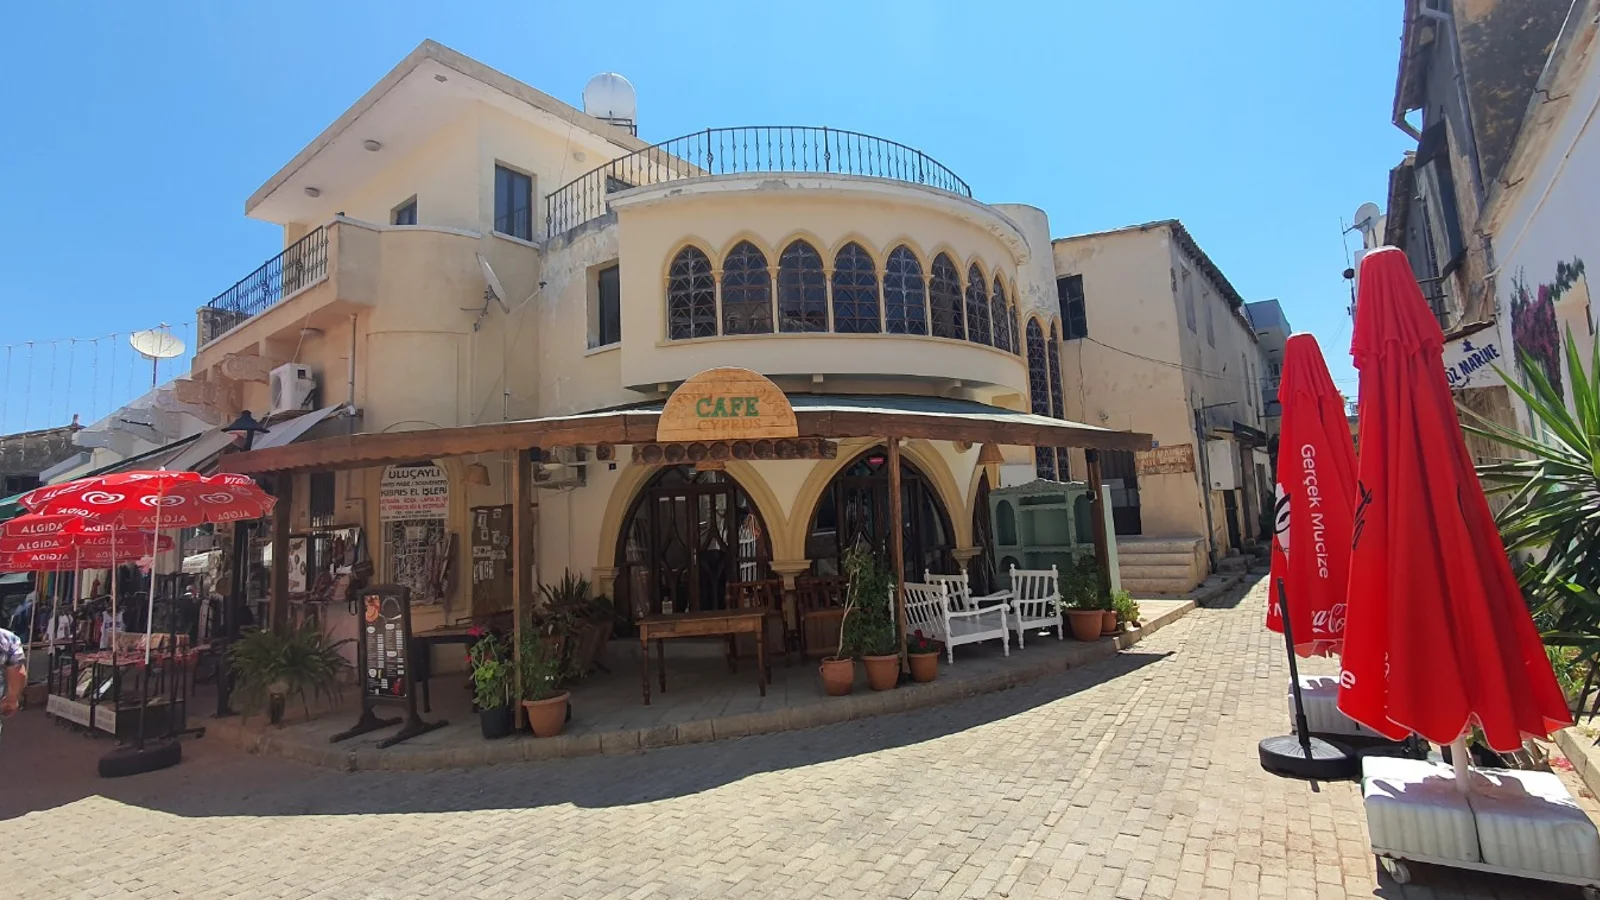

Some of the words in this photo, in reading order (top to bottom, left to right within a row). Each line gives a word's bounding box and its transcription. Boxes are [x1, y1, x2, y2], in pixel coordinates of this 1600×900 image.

[696, 397, 760, 418] CAFE
[1300, 443, 1320, 509] Gerçek
[1310, 512, 1329, 579] Mucize
[20, 522, 63, 534] ALGIDA
[17, 540, 60, 551] ALGIDA
